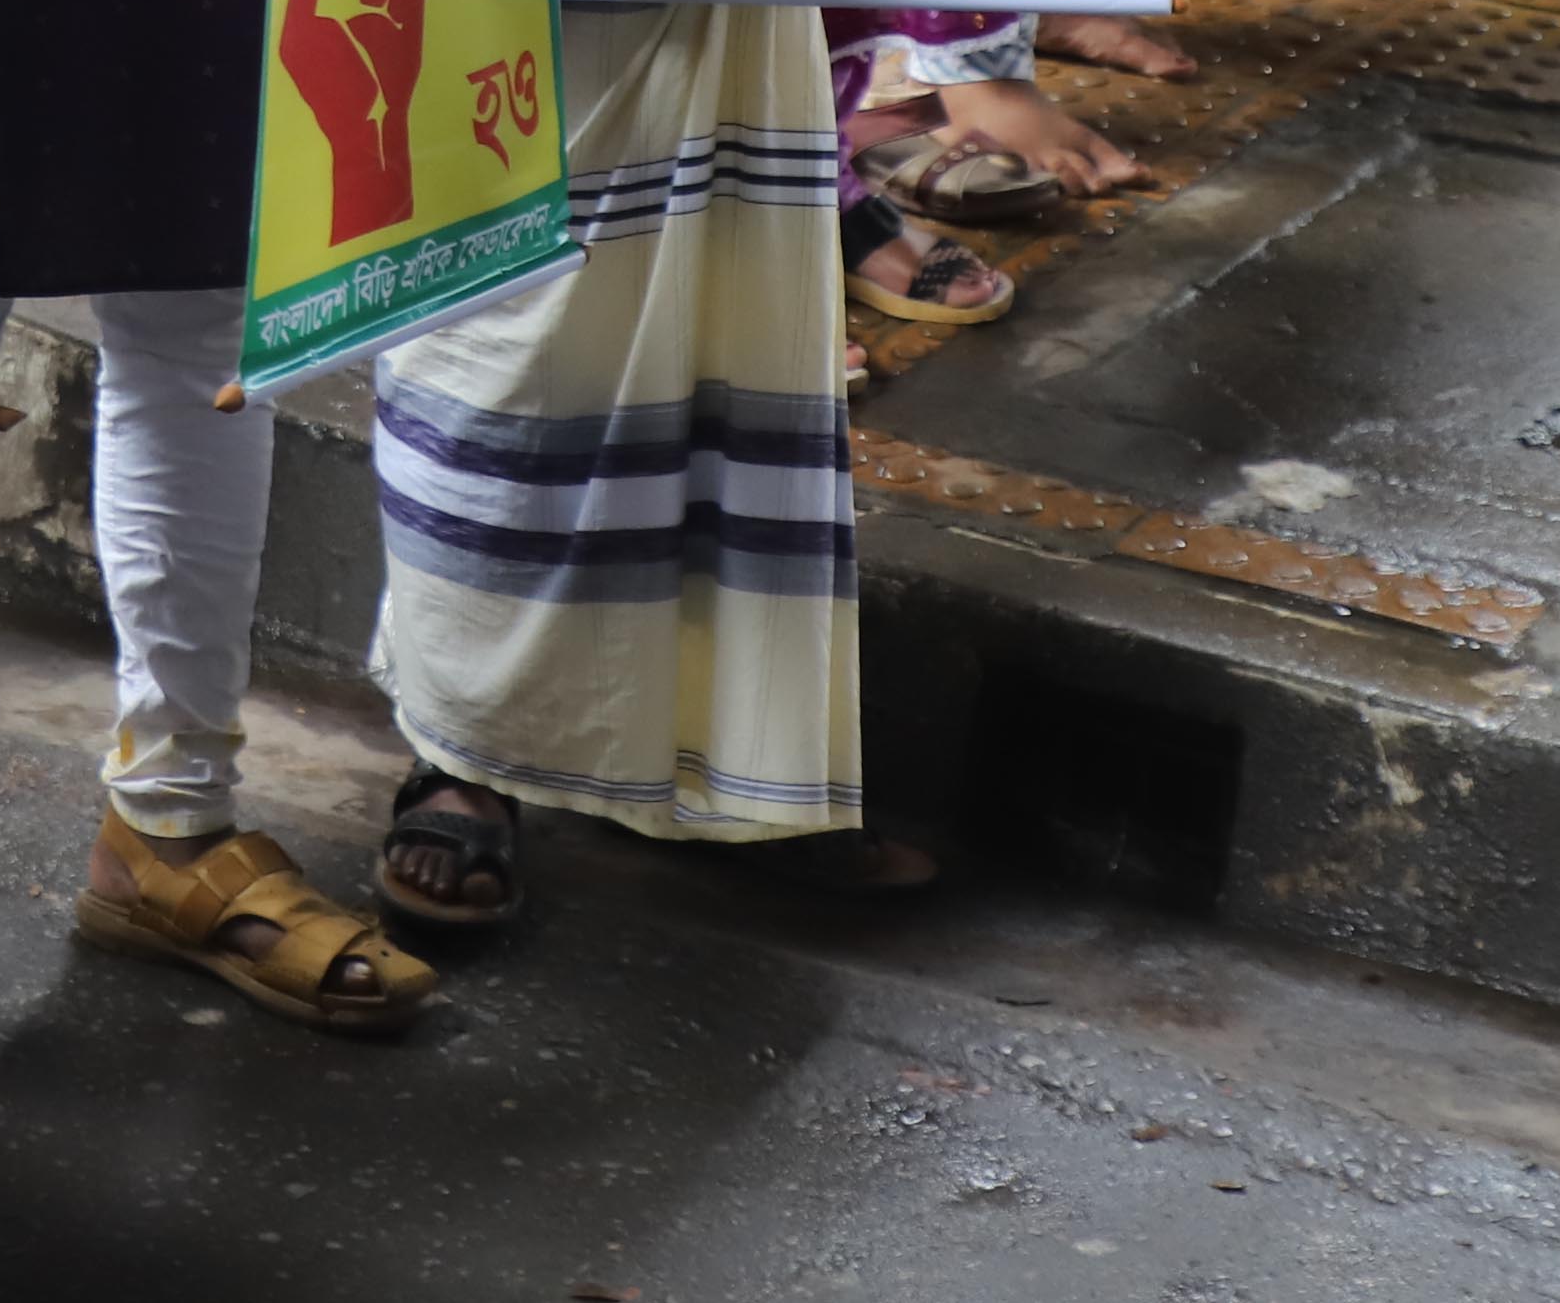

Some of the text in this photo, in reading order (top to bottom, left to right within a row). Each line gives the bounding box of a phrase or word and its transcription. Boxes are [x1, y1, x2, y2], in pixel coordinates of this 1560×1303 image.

[465, 48, 542, 171] হও
[258, 277, 348, 351] বাংলাদেশ
[353, 259, 398, 312] বিড়ি
[401, 238, 454, 296] শ্রমিক
